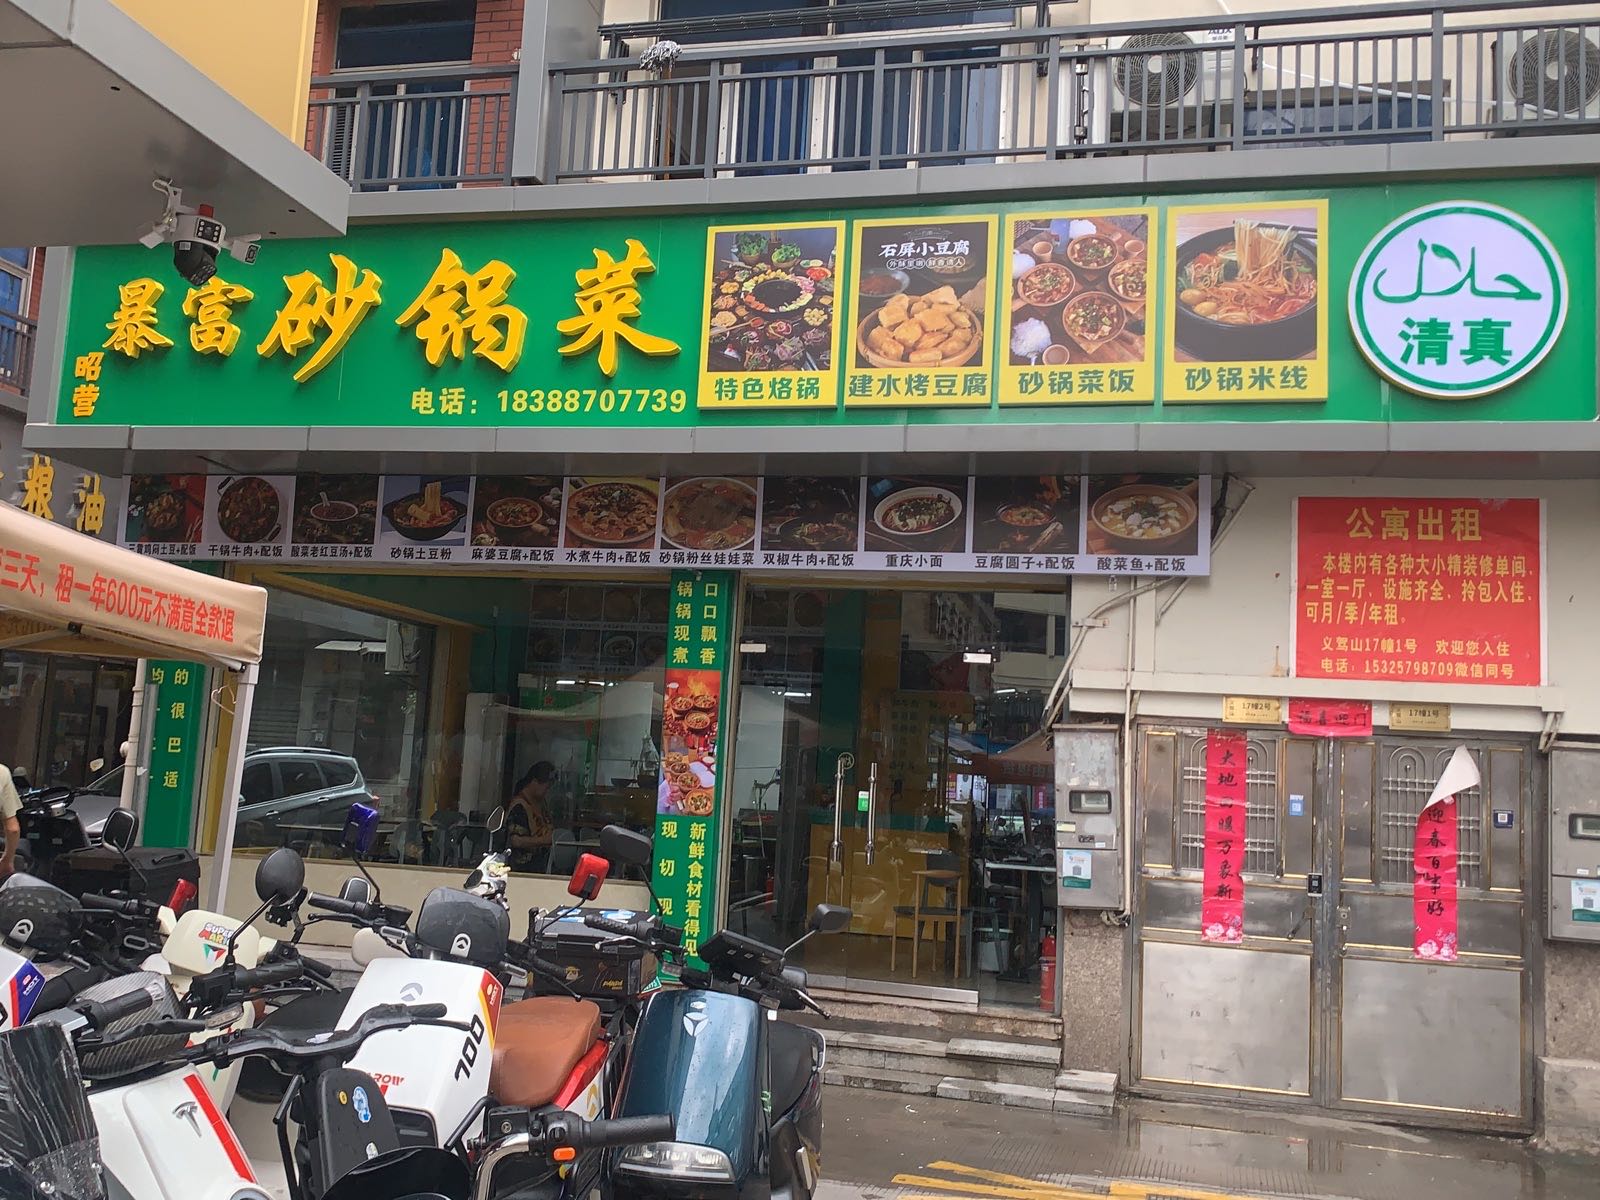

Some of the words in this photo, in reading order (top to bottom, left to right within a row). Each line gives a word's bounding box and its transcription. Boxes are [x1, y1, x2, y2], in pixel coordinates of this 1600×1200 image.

[878, 239, 970, 258] 石屏小豆腐
[1372, 238, 1543, 304] حلال
[1397, 317, 1513, 366] 清真
[73, 351, 105, 417] 昭营
[714, 376, 820, 402] 特色烙锅
[848, 373, 988, 398] 建水烤豆腐
[1018, 368, 1135, 395] 砂锅菜饭
[1185, 365, 1309, 393] 砂锅米线
[0, 453, 105, 534] 粮油
[1345, 506, 1483, 542] 公寓出租
[207, 544, 284, 558] 干锅牛肉+配饭
[390, 546, 453, 561] 砂锅土豆粉
[470, 548, 556, 563] 麻婆豆腐+配饭
[564, 549, 652, 564] 水煮牛肉+配饭
[659, 550, 756, 566] 砂锅粉丝娃娃菜
[762, 552, 855, 567] 双椒牛肉+配饭
[884, 553, 944, 568] 重庆小面
[974, 555, 1076, 571] 豆腐圆子+配饭
[1095, 556, 1187, 572] 酸菜鱼+配饭
[0, 548, 236, 643] 三天，租一年600元不满意全款退
[672, 580, 693, 665] 锅锅现煮
[699, 583, 719, 665] 口口飘香
[1435, 639, 1511, 657] 欢迎您入住
[683, 822, 707, 957] 新鲜食材看得见
